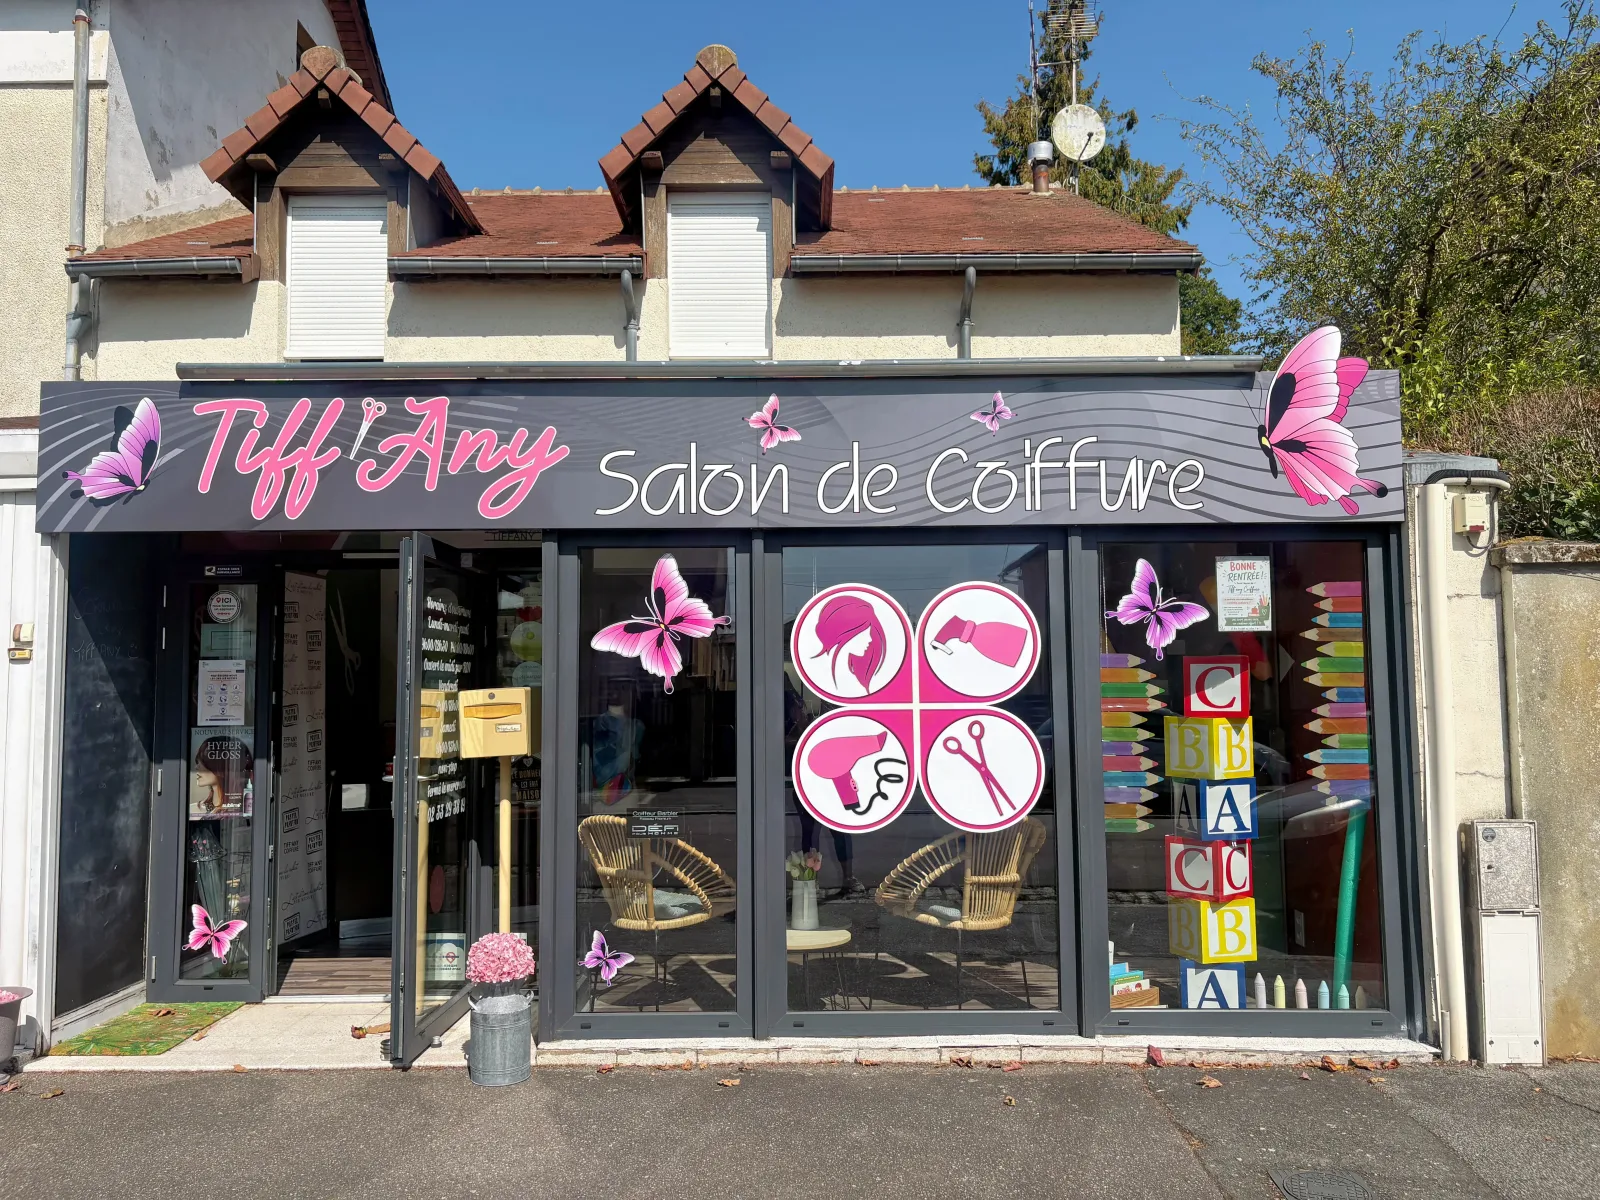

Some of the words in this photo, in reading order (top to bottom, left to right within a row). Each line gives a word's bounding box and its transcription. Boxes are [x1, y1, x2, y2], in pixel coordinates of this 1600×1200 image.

[594, 441, 790, 516] Salon
[817, 441, 898, 514] de
[925, 436, 1205, 514] Coiffure
[1230, 561, 1257, 572] BONNE
[1195, 666, 1237, 709] C
[207, 741, 242, 750] HYPER
[207, 750, 241, 760] GLOSS
[1174, 725, 1204, 769] B
[1222, 725, 1248, 771] B
[516, 789, 540, 801] MAISO
[1176, 784, 1198, 833] A
[1209, 786, 1251, 833] A
[1174, 847, 1210, 892] C
[1225, 846, 1248, 891] C
[1176, 904, 1196, 952] B
[1214, 908, 1248, 955] B
[1197, 970, 1232, 1009] A
